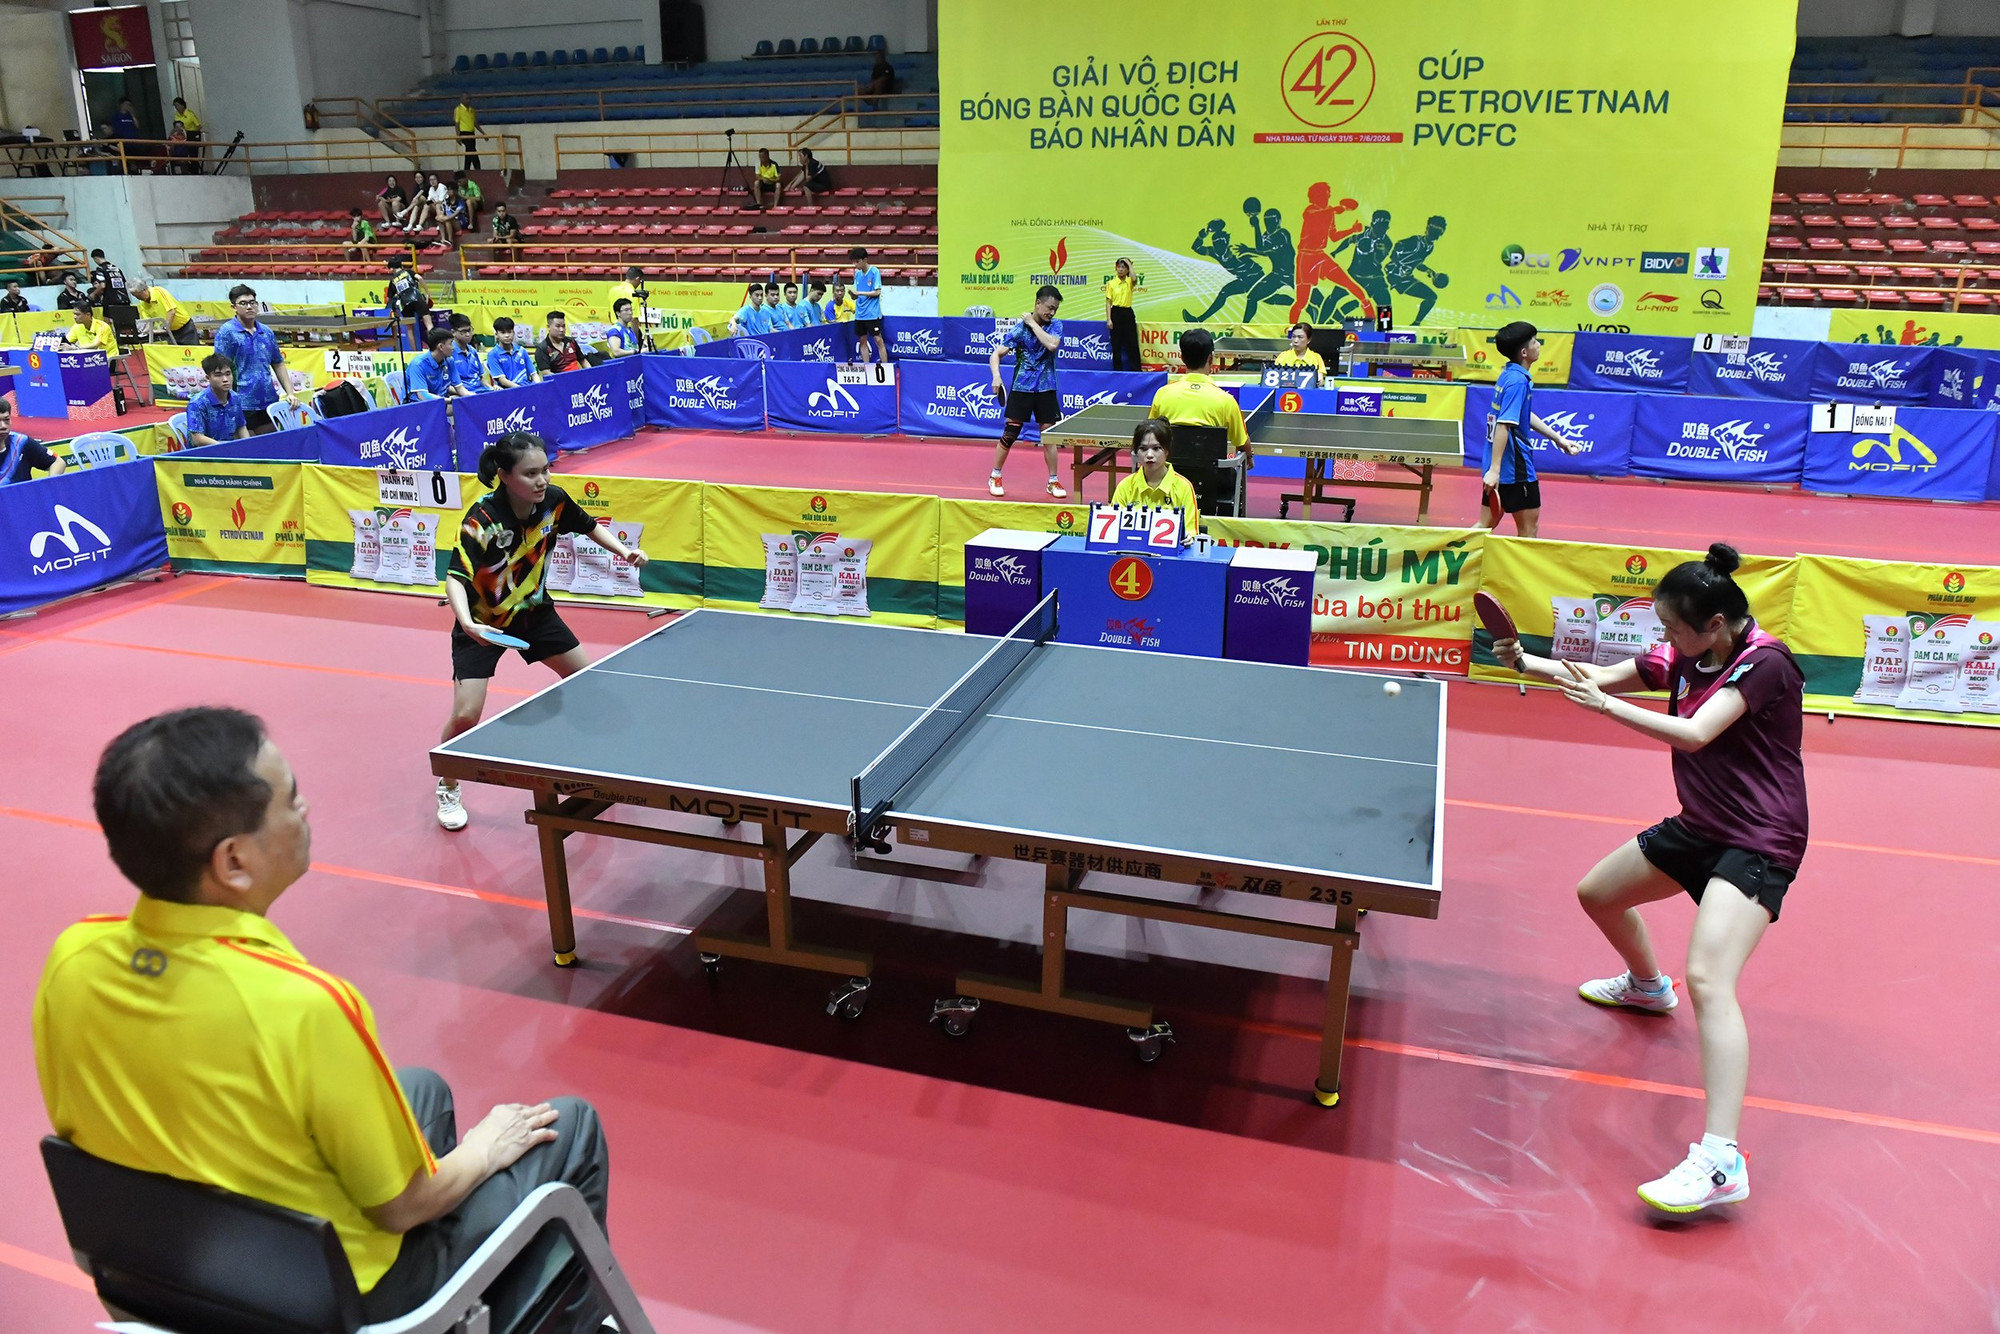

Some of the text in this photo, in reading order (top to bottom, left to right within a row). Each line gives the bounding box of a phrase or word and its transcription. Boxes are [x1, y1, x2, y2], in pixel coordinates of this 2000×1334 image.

[101, 52, 132, 64] SAIGON
[1418, 49, 1484, 80] CÚP
[1053, 55, 1238, 89] GIẢI VÔ ĐỊCH
[1290, 44, 1357, 105] 42
[960, 82, 1236, 121] BÓNG BÀN QUỐC GIA
[1415, 89, 1669, 114] PETROVIETNAM
[1030, 117, 1235, 149] BÁO NHÂN DÂN
[1282, 135, 1306, 143] TRANG,
[1308, 134, 1318, 142] TỪ
[1318, 134, 1337, 142] NGÀY
[1413, 123, 1517, 147] PVCFC
[1011, 217, 1103, 227] NHÀ ĐỒNG HÀNH CHÍNH
[1587, 222, 1649, 233] NHÀ TÀI TRỢ
[1583, 256, 1636, 267] VNPT
[1644, 258, 1674, 270] BIDV
[961, 273, 1015, 284] PHÂN BÓN CÀ MAU
[1030, 274, 1087, 285] PETROVIETNAM
[1635, 304, 1679, 313] LI-NING
[1141, 329, 1169, 344] NPK
[892, 343, 943, 355] DOUBLE FISH
[964, 344, 993, 355] DOUBLE
[1722, 339, 1748, 351] TIMES CITY
[30, 354, 40, 368] 8
[333, 351, 341, 370] 2
[349, 353, 372, 362] CÔNG AN
[1058, 348, 1113, 360] DOUBLE FISH
[1142, 348, 1164, 359] Cho
[1605, 350, 1624, 363] 双魚
[875, 365, 885, 383] 0
[1596, 364, 1663, 379] DOUBLE FISH
[1716, 366, 1786, 383] DOUBLE FISH
[1849, 362, 1868, 375] 双魚
[676, 378, 695, 393] 双魚
[1265, 370, 1314, 388] 8 7
[1837, 376, 1907, 389] DOUBLE FISH
[571, 392, 585, 408] 双魚
[936, 385, 957, 400] 双魚
[669, 395, 737, 410] DOUBLE FISH
[1062, 393, 1084, 408] 双魚
[1284, 393, 1298, 412] 5
[808, 409, 860, 418] MOFIT
[926, 402, 1002, 420] DOUBLE FISH
[1340, 404, 1359, 413] Double
[568, 407, 613, 427] DOUBLE FISH
[1827, 404, 1836, 429] 1
[1855, 413, 1893, 427] ĐỒNG NAI 1
[486, 417, 505, 436] 双魚
[1681, 421, 1709, 440] 双魚
[360, 440, 381, 459] 双魚
[1666, 441, 1768, 463] DOUBLE FISH
[407, 453, 427, 469] FISH
[1849, 462, 1936, 473] MOFIT
[226, 478, 242, 486] HÀNH
[243, 479, 262, 487] CHÍNH
[380, 473, 414, 486] THANH PHỐ
[381, 487, 418, 501] HỒ CHÍ MINH 2
[431, 474, 447, 505] 0
[282, 520, 299, 529] NPK
[1096, 514, 1175, 544] 7 2 1 2
[220, 529, 264, 541] PETROVIETNAM
[275, 531, 293, 542] PHÚ
[361, 541, 377, 549] DAP
[412, 544, 431, 552] KALI
[1197, 537, 1208, 553] T
[33, 547, 112, 576] MOFIT
[553, 551, 571, 559] DAP
[1303, 537, 1470, 585] PHÚ MỸ
[975, 557, 992, 570] 双魚
[773, 568, 794, 576] DAP
[969, 570, 1032, 585] Double FISH
[1115, 562, 1140, 595] 4
[1611, 574, 1625, 583] PHÂN
[1242, 579, 1261, 592] 双魚
[1234, 593, 1305, 609] Double FISH
[1358, 595, 1461, 623] bội thu
[1099, 631, 1161, 648] DOUBLE FISH
[1563, 636, 1590, 646] DAP
[1344, 640, 1462, 665] TIN DÙNG
[1874, 656, 1902, 667] DAP
[1964, 660, 1995, 670] KALI
[1885, 666, 1902, 674] MAU
[593, 789, 648, 806] Double FISH
[668, 794, 811, 829] MOFIT
[1013, 843, 1162, 880] 世乒赛器材供应商
[1241, 875, 1353, 905] 双鱼 235
